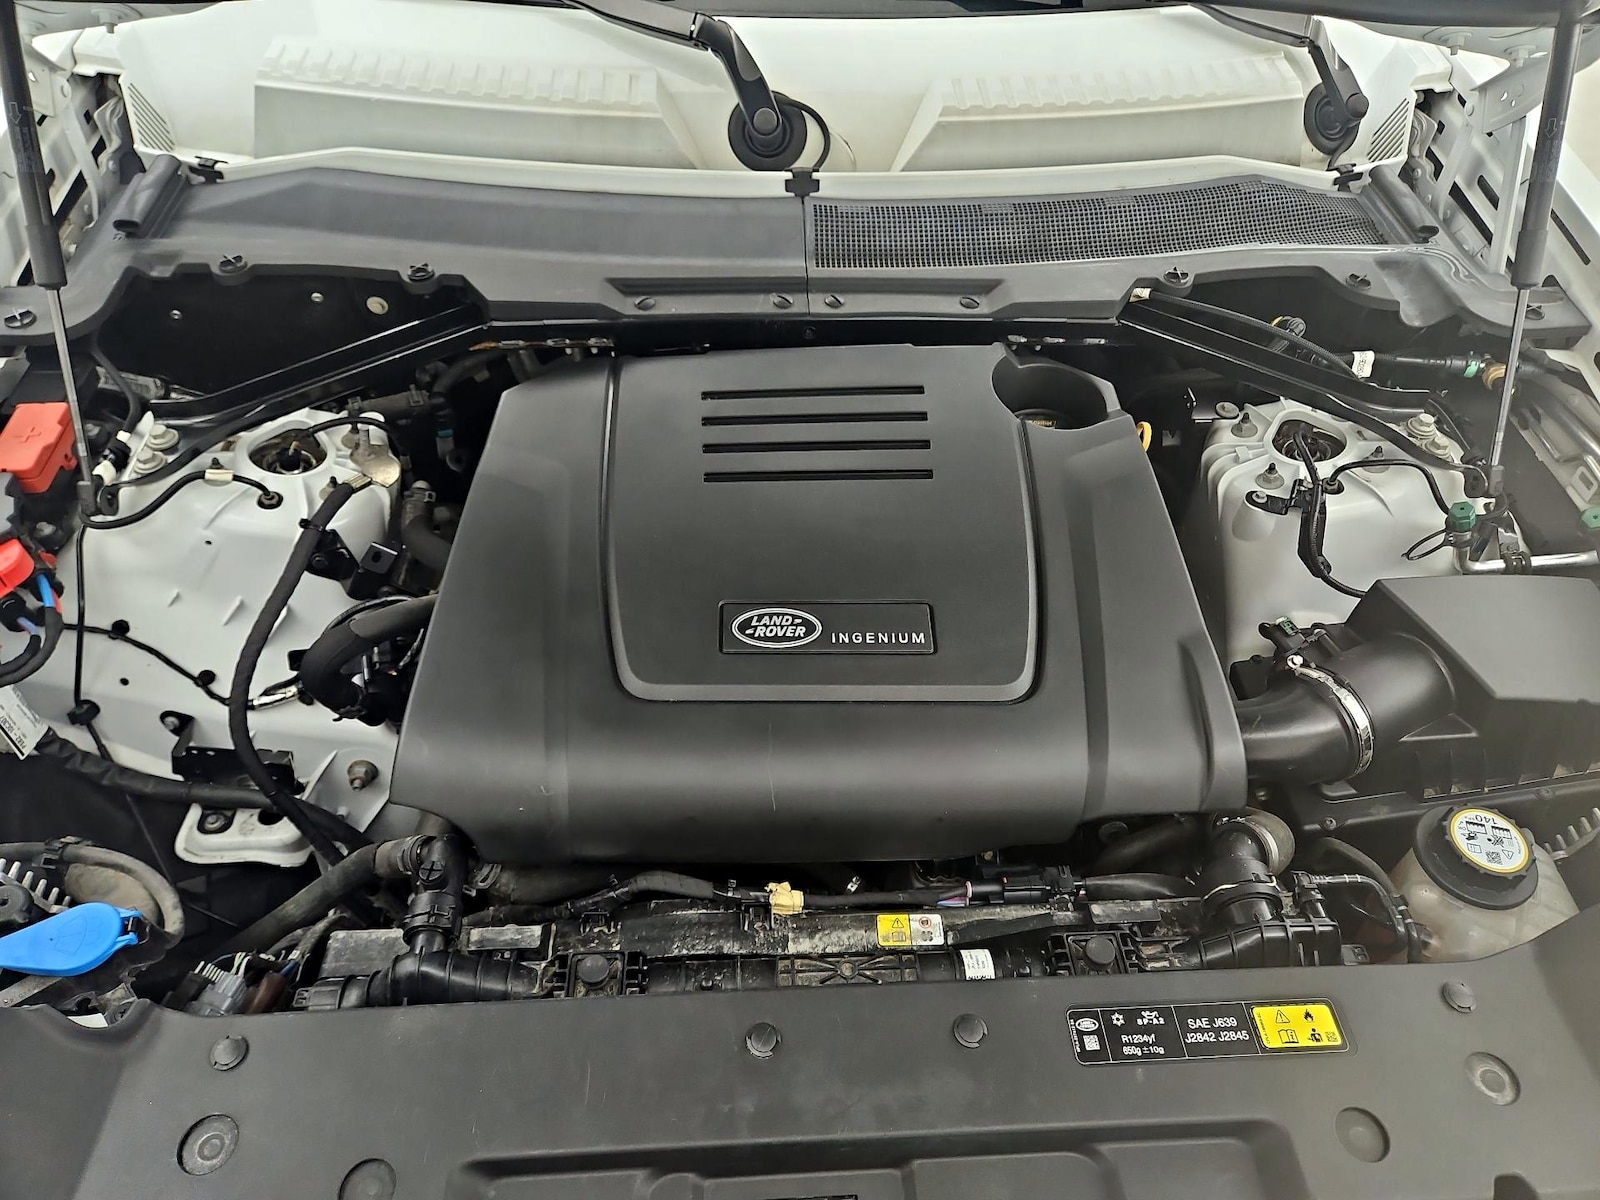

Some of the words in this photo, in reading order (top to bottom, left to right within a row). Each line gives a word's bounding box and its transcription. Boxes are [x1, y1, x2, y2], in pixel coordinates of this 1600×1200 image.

[753, 626, 807, 638] ROVER
[831, 632, 926, 645] INGENIUM
[1187, 1018, 1211, 1030] SAE
[1212, 1016, 1238, 1028] J639
[1185, 1032, 1217, 1044] J2842
[1218, 1030, 1250, 1042] J2845
[1122, 1045, 1142, 1057] 650g
